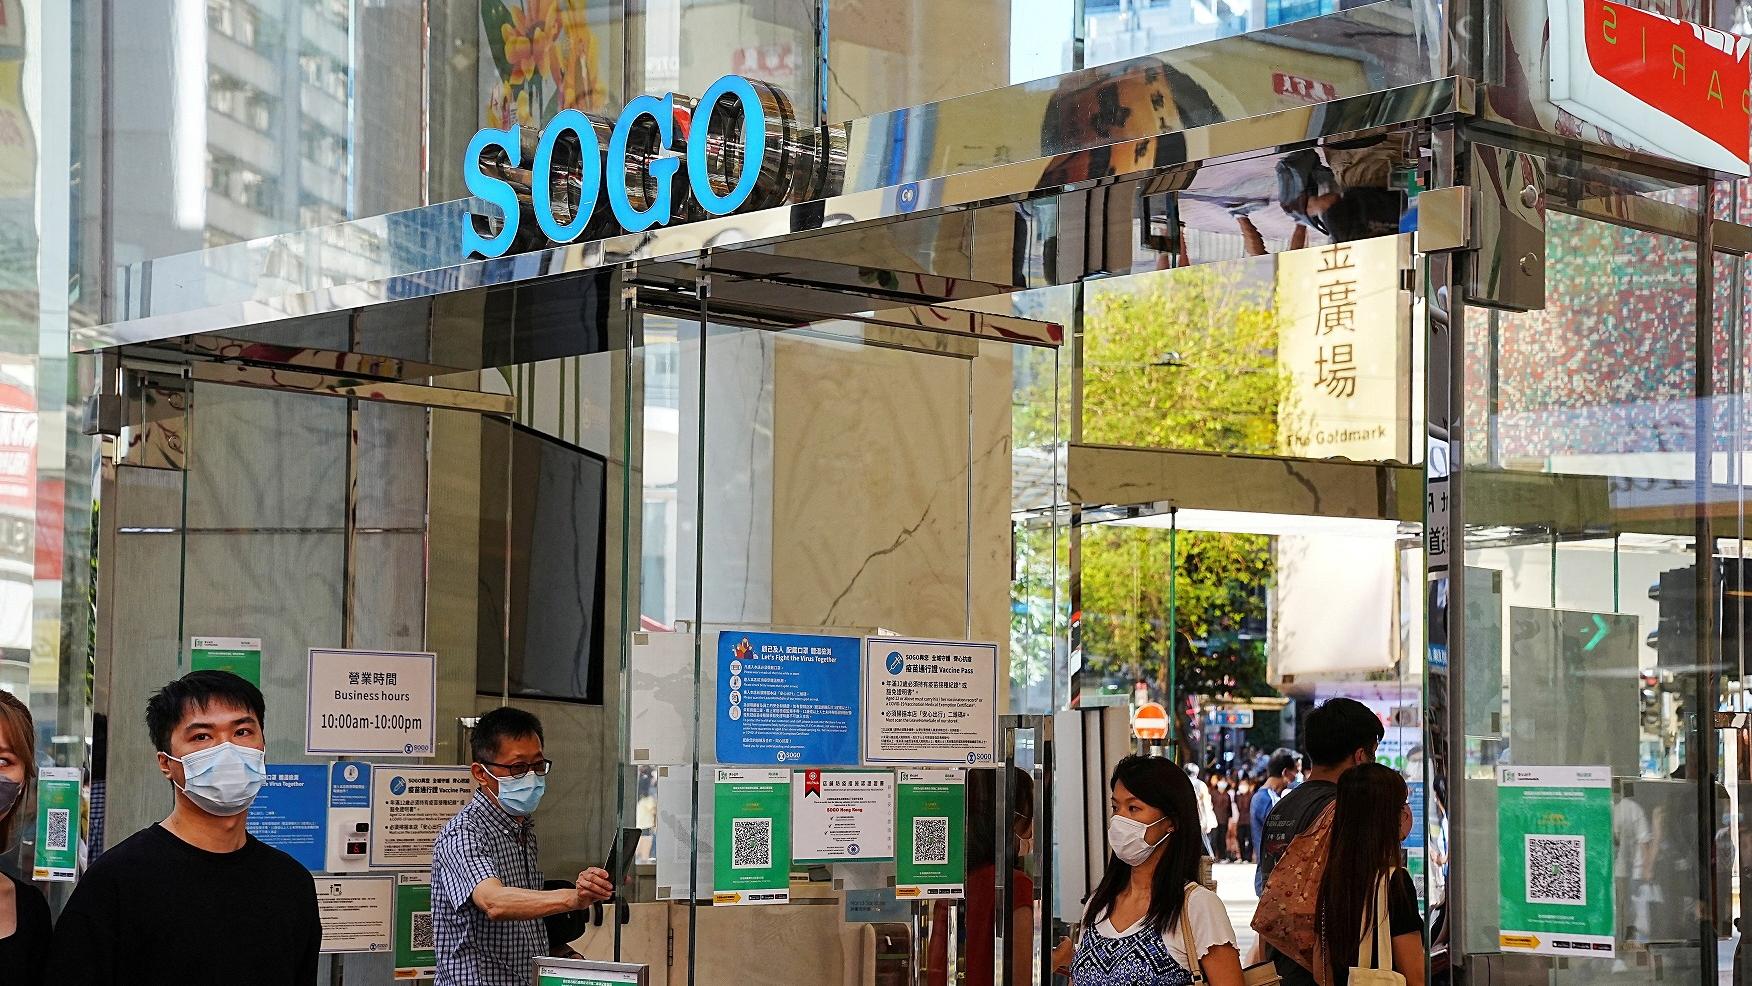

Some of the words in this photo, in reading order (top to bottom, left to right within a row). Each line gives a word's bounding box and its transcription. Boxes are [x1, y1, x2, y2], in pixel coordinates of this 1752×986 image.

[462, 74, 766, 258] SOGO
[1316, 424, 1387, 445] Goldmark
[775, 654, 791, 662] Fight
[815, 655, 837, 664] Together
[939, 666, 960, 674] Vaccine
[349, 672, 397, 686] 營業時間
[334, 690, 380, 700] Business
[381, 691, 410, 701] hours
[321, 713, 422, 733] 10:00am-10:00pm
